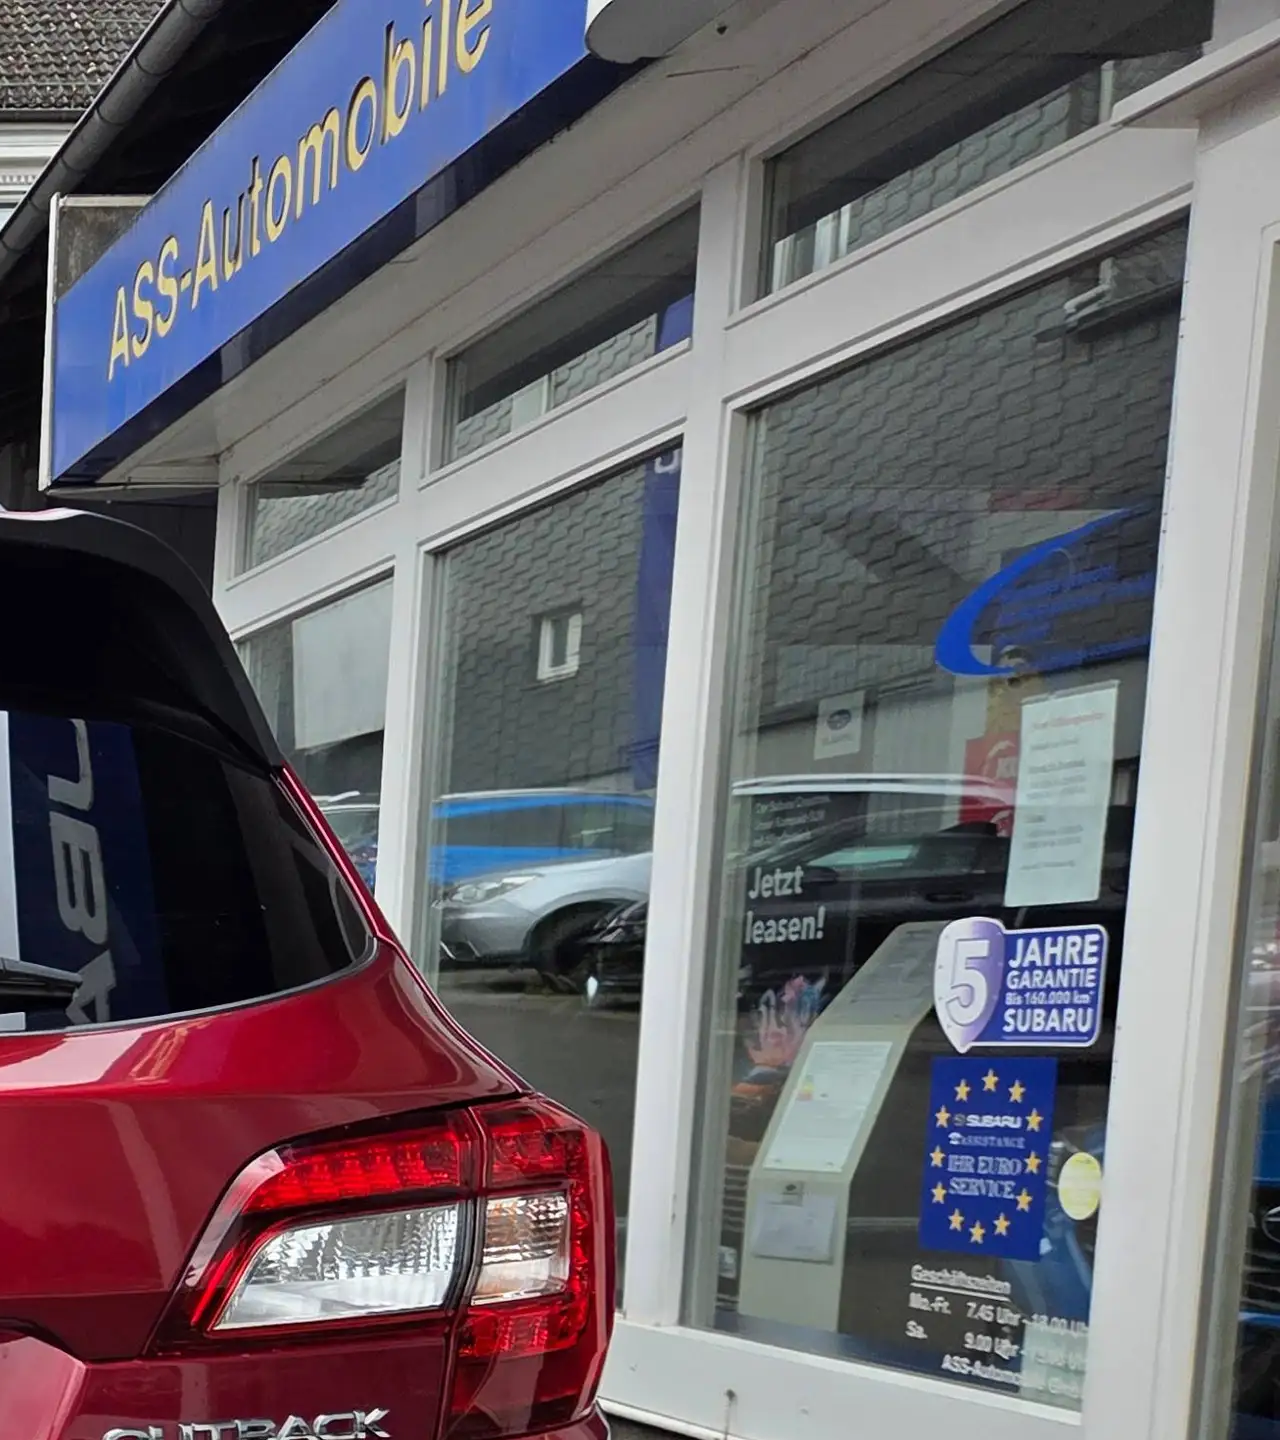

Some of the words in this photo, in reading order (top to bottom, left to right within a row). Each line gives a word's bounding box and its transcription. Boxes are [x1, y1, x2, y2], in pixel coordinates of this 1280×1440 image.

[106, 0, 492, 382] ASS-Automobile
[748, 866, 803, 899] Jetzt
[745, 906, 826, 944] leasen!
[1008, 934, 1100, 968] JAHRE
[946, 939, 990, 1027] 5
[1006, 968, 1097, 990] GARANTIE
[1002, 1008, 1093, 1033] SUBARU
[966, 1114, 1022, 1129] SUBARU
[977, 1156, 1022, 1176] EURO
